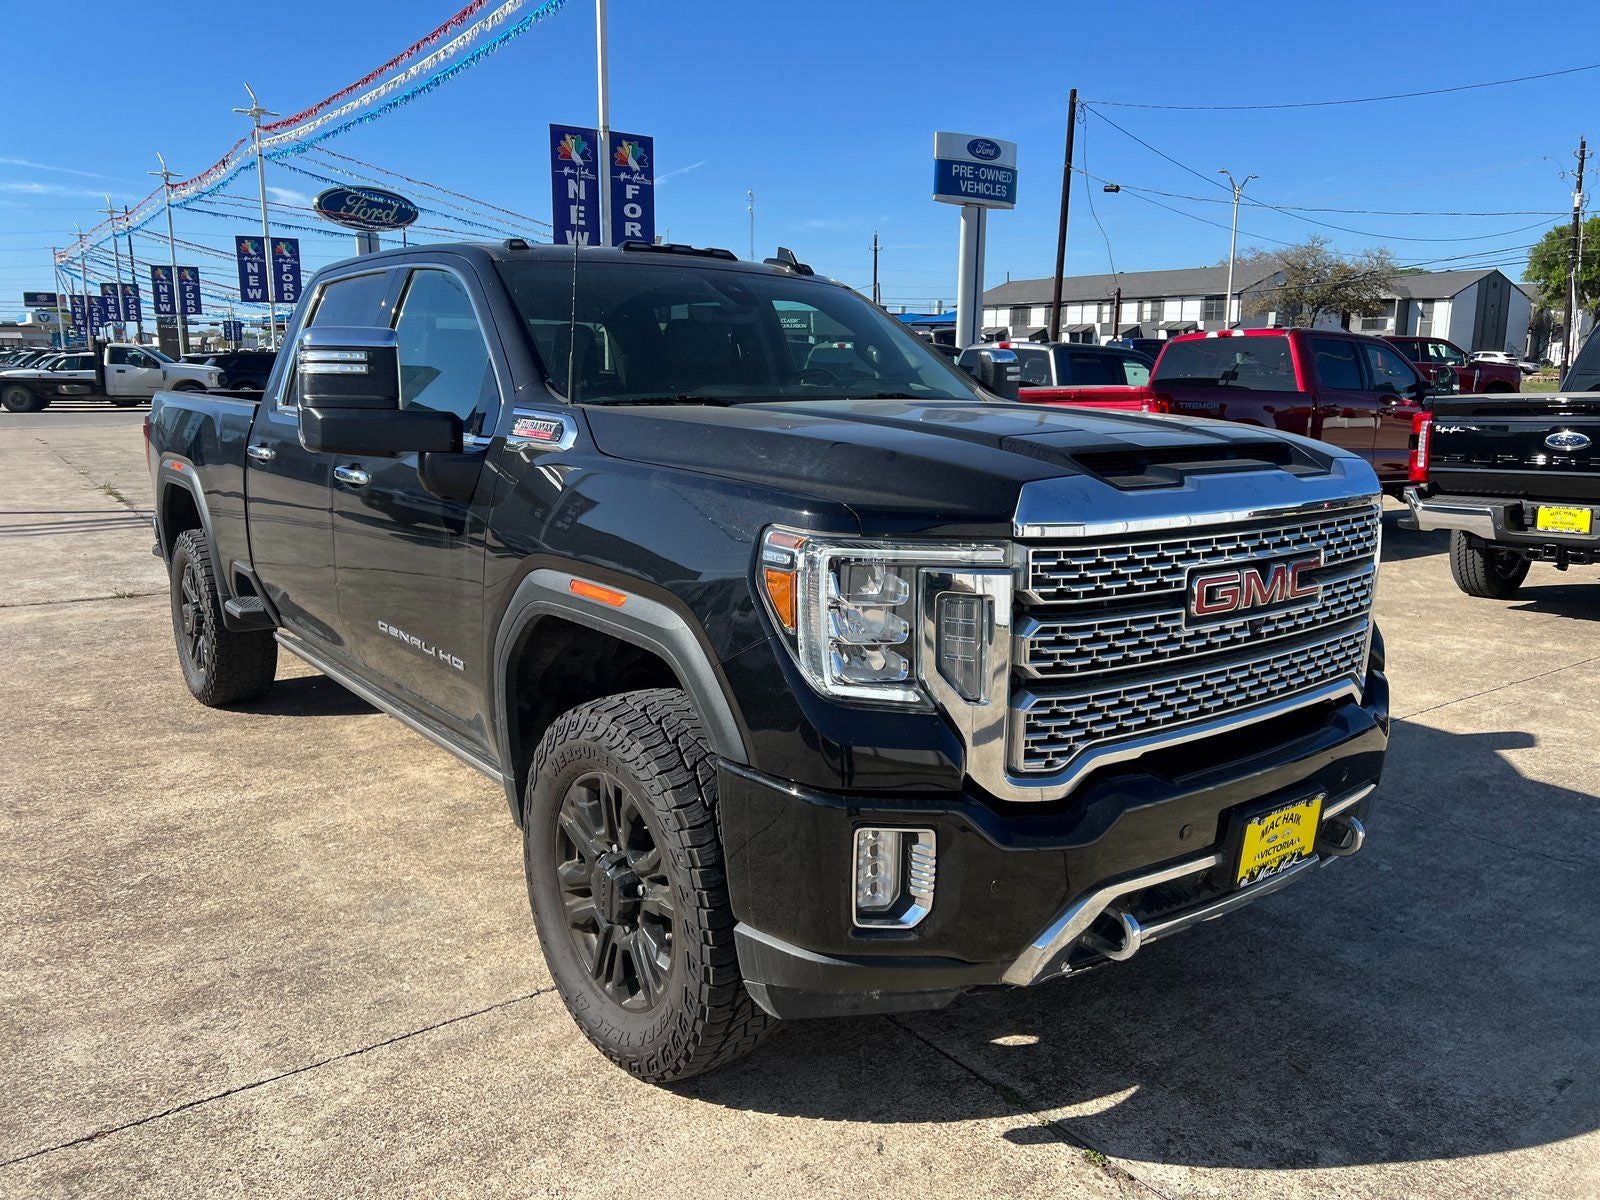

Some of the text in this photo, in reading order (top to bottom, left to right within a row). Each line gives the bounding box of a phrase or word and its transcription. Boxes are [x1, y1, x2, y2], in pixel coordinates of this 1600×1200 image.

[976, 141, 995, 156] Ford
[952, 164, 1013, 183] PRE-OWNED
[960, 180, 1007, 197] VEHICLES
[341, 194, 400, 223] Ford
[566, 179, 590, 245] NEW
[246, 262, 262, 299] NEW
[281, 264, 295, 301] FORD
[107, 298, 117, 320] NEW
[128, 298, 137, 320] FORD
[158, 284, 171, 312] NEW
[185, 285, 196, 313] FORD
[74, 307, 83, 325] NEW
[1179, 402, 1220, 410] TREMOR
[520, 420, 554, 432] DURAMAX
[1194, 556, 1321, 616] GMC
[377, 620, 465, 671] DENALI HD
[1260, 816, 1281, 842] MAC
[1282, 812, 1302, 826] HAIK
